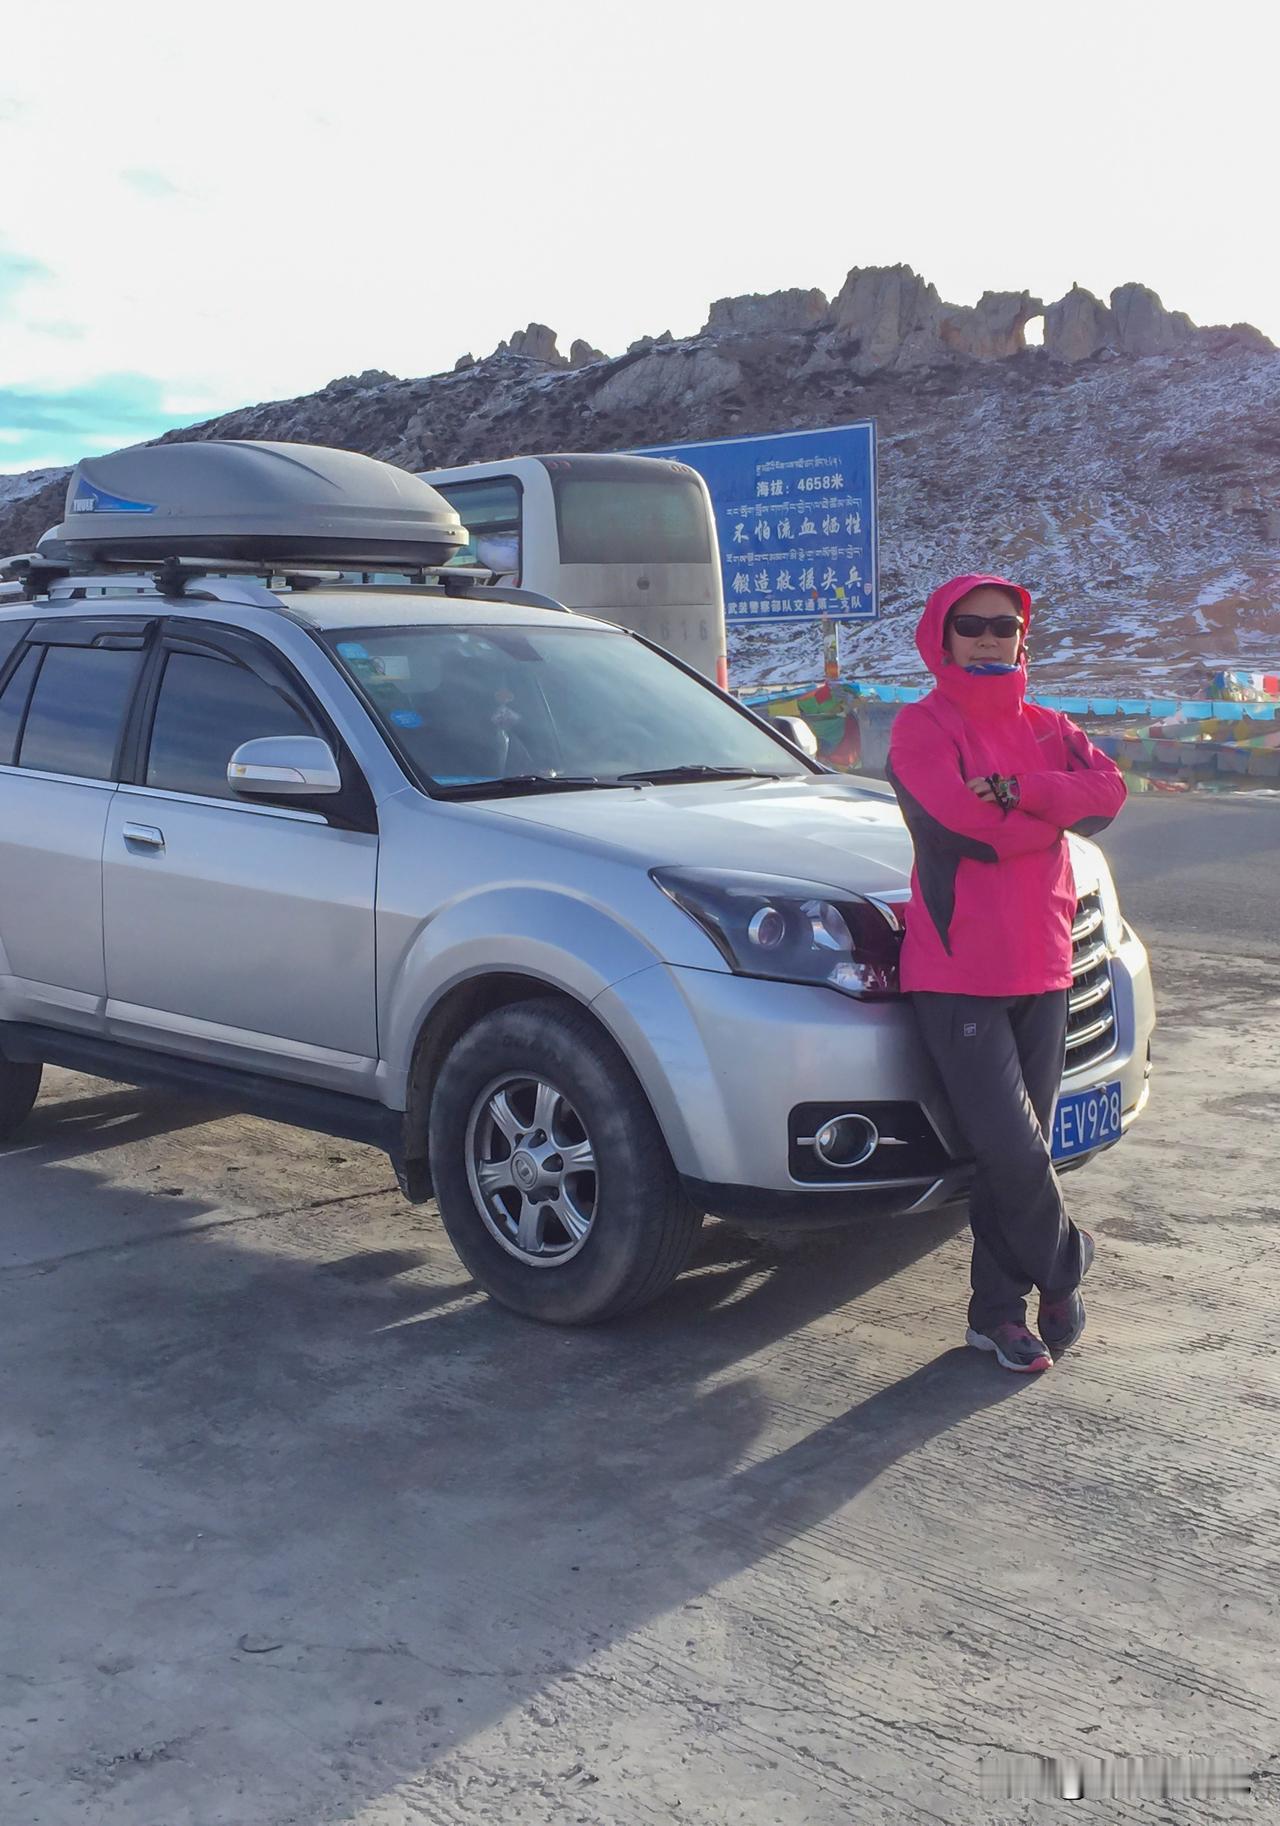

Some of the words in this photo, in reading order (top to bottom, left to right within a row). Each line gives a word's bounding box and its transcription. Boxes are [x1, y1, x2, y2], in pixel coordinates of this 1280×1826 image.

[732, 511, 862, 543] 不怕流血牺牲
[731, 565, 862, 594] 锻造救援尖兵
[724, 595, 862, 615] 武装警察部队交通第二支队
[1060, 1091, 1119, 1149] EV928
